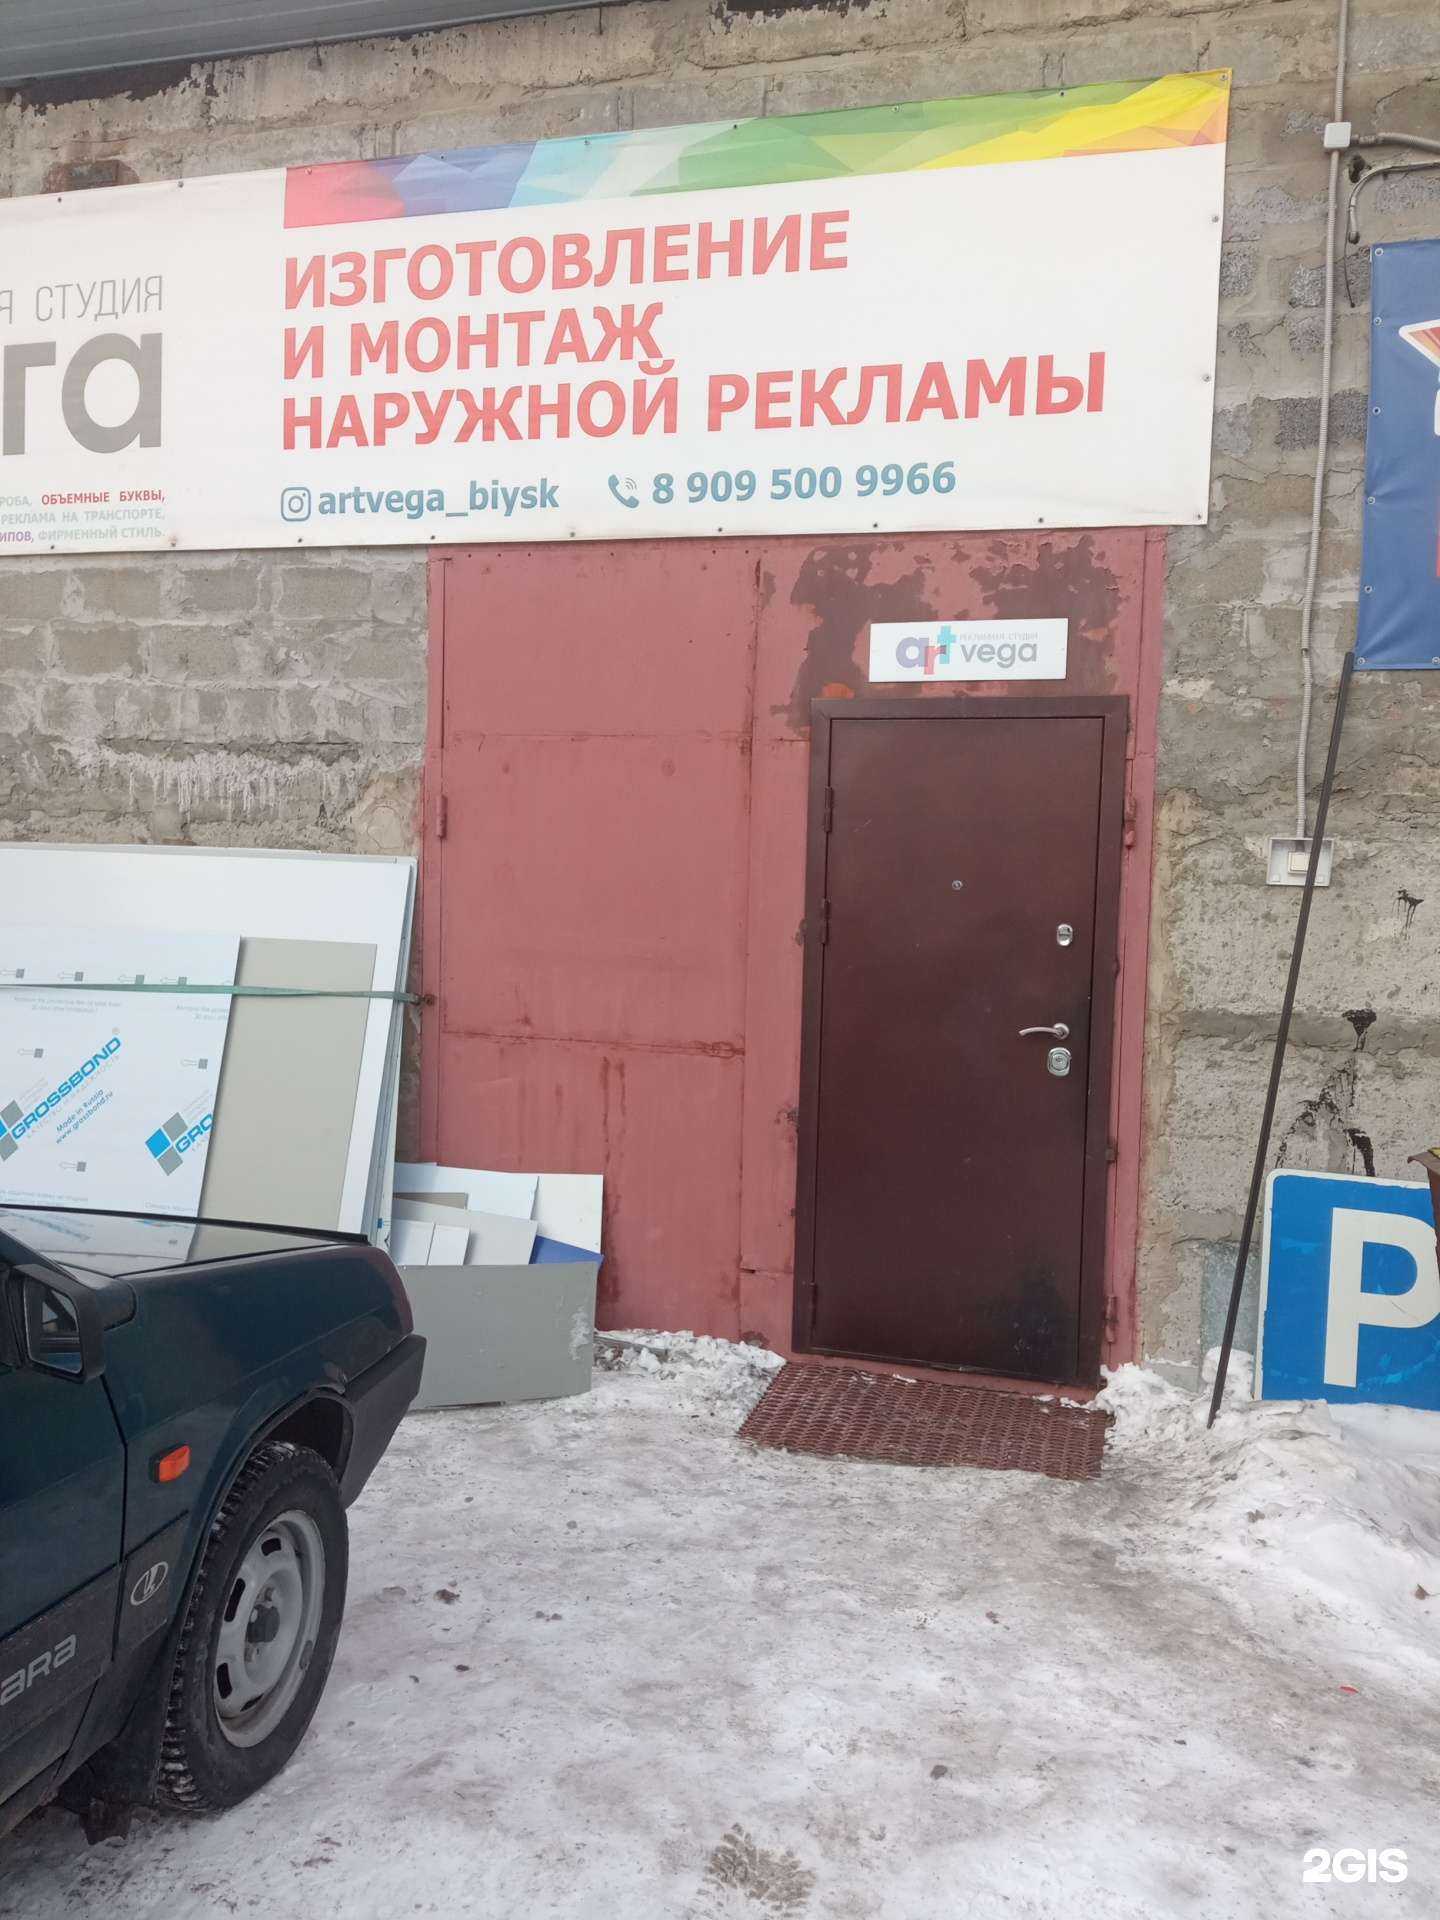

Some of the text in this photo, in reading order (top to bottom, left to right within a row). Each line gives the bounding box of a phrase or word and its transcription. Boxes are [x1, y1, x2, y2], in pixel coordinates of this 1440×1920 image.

[284, 209, 850, 311] ИЗГОТОВЛЕНИЕ
[35, 274, 163, 322] СТУДИЯ
[283, 302, 664, 380] И МОНТАЖ
[283, 351, 1106, 450] НАРУЖНОЙ РЕКЛАМЫ
[41, 491, 110, 506] ОБЪЕМНЫЕ
[119, 489, 165, 503] БУКВЫ,
[317, 477, 561, 520] artvega_biysk
[652, 461, 956, 504] 8 909 500 9966
[1, 511, 56, 525] РЕКЛАМА
[62, 511, 78, 523] НА
[38, 527, 118, 541] ФИРМЕННЫЙ
[896, 625, 1038, 675] art vega
[11, 1036, 121, 1140] GROSSBOND
[1324, 1207, 1440, 1388] P
